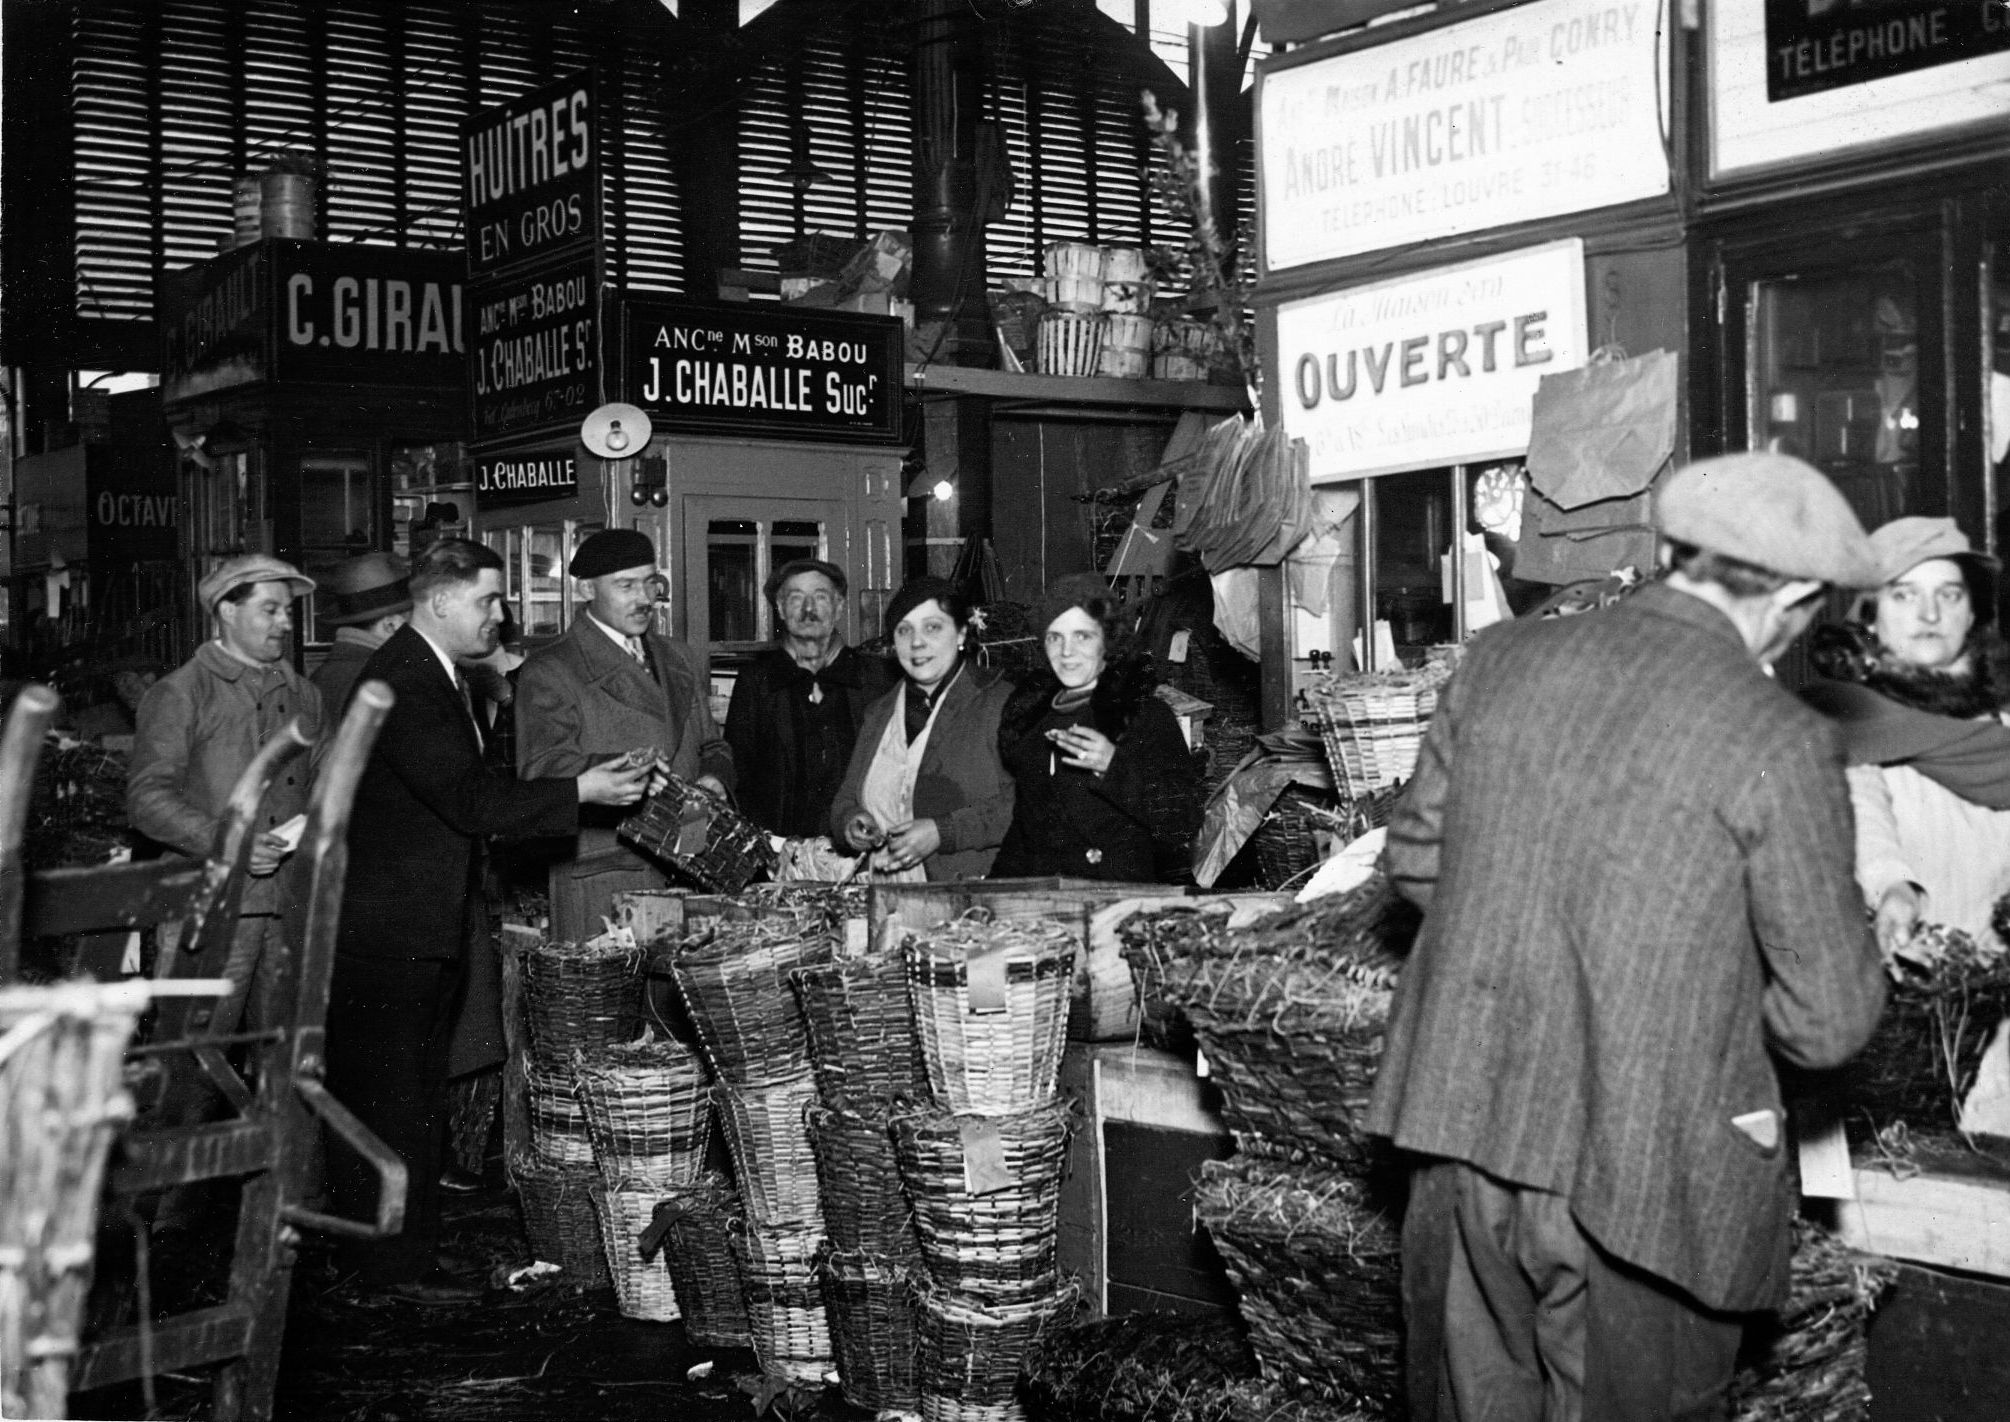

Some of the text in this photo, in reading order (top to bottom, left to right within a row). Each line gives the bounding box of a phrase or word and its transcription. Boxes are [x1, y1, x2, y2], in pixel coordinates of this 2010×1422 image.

[1442, 166, 1525, 209] LOUVRE
[482, 193, 581, 261] EN GROS
[531, 276, 585, 320] BABOU
[786, 334, 867, 364] BABOU
[1293, 309, 1555, 412] OUVERTE
